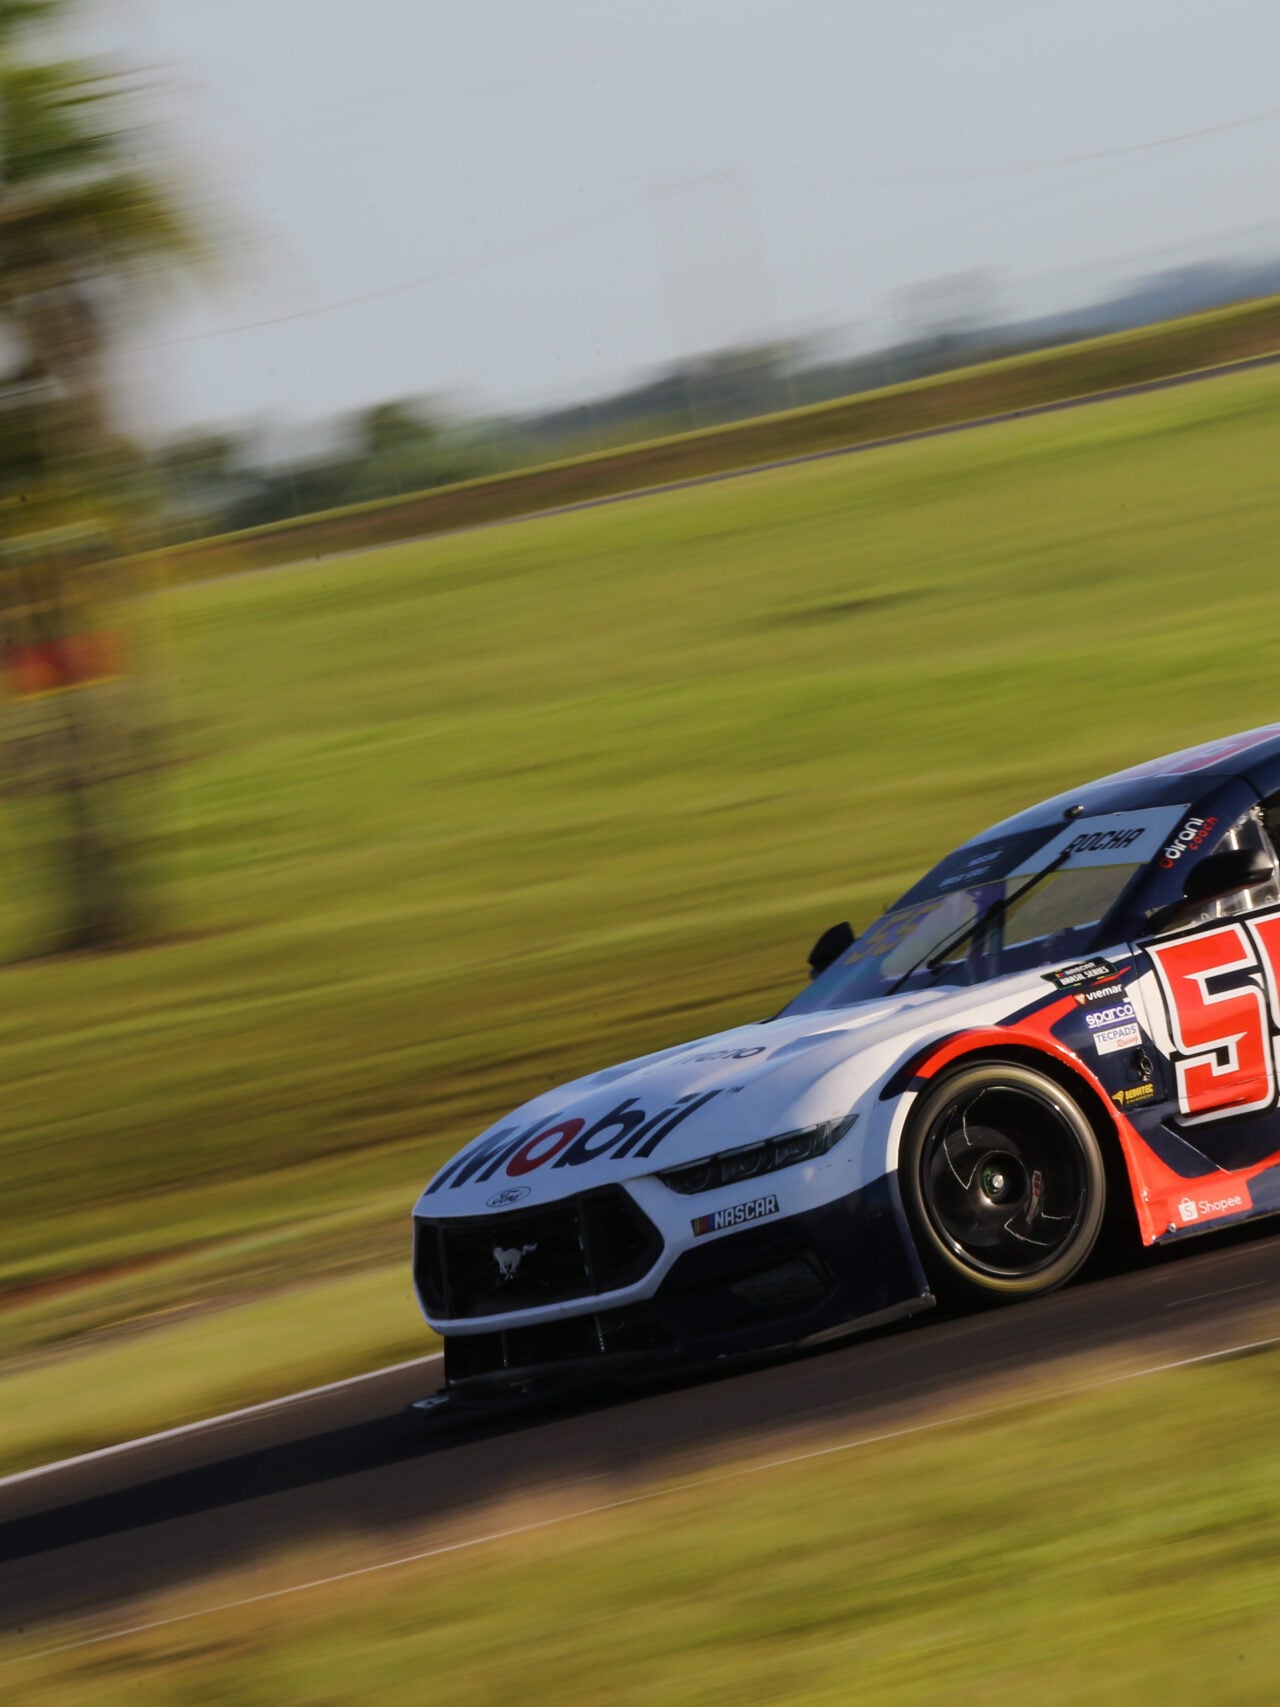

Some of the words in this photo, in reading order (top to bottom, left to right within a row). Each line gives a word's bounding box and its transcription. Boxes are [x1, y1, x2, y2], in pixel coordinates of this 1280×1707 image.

[1061, 828, 1147, 856] ROCHA
[1164, 817, 1205, 860] dirani
[1188, 816, 1218, 850] coach
[1060, 971, 1087, 986] BRASIL
[1086, 965, 1110, 981] SERIES
[1086, 984, 1123, 1001] viemar
[1085, 1004, 1134, 1028] sparco
[1096, 1024, 1138, 1044] TECPADS
[424, 1088, 725, 1196] Mobil
[713, 1196, 776, 1231] NASCAR
[1198, 1195, 1243, 1215] Shopee
